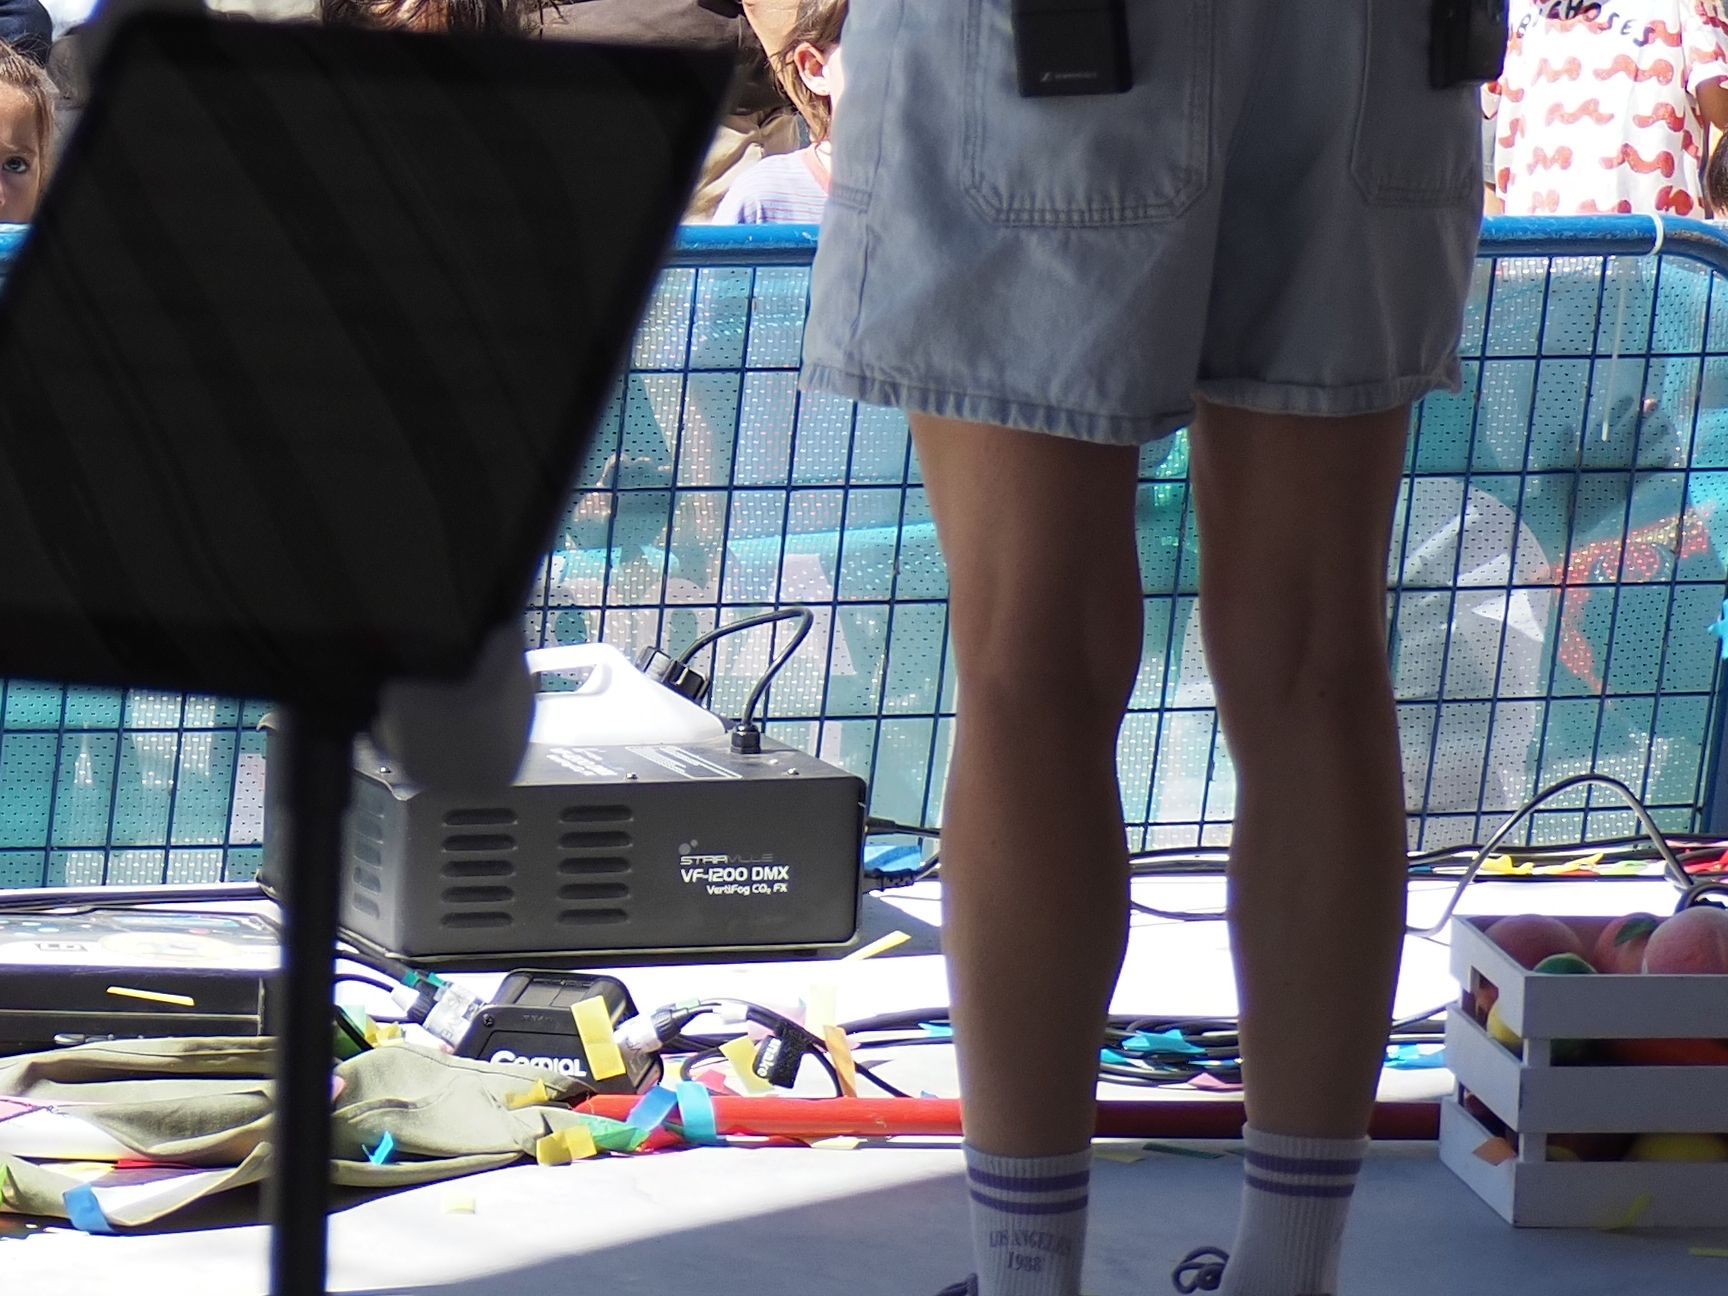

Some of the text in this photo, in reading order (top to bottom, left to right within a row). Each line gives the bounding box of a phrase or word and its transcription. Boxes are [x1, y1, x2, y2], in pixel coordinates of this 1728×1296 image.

[680, 865, 790, 883] VF-1200 DMX
[773, 882, 788, 893] FX
